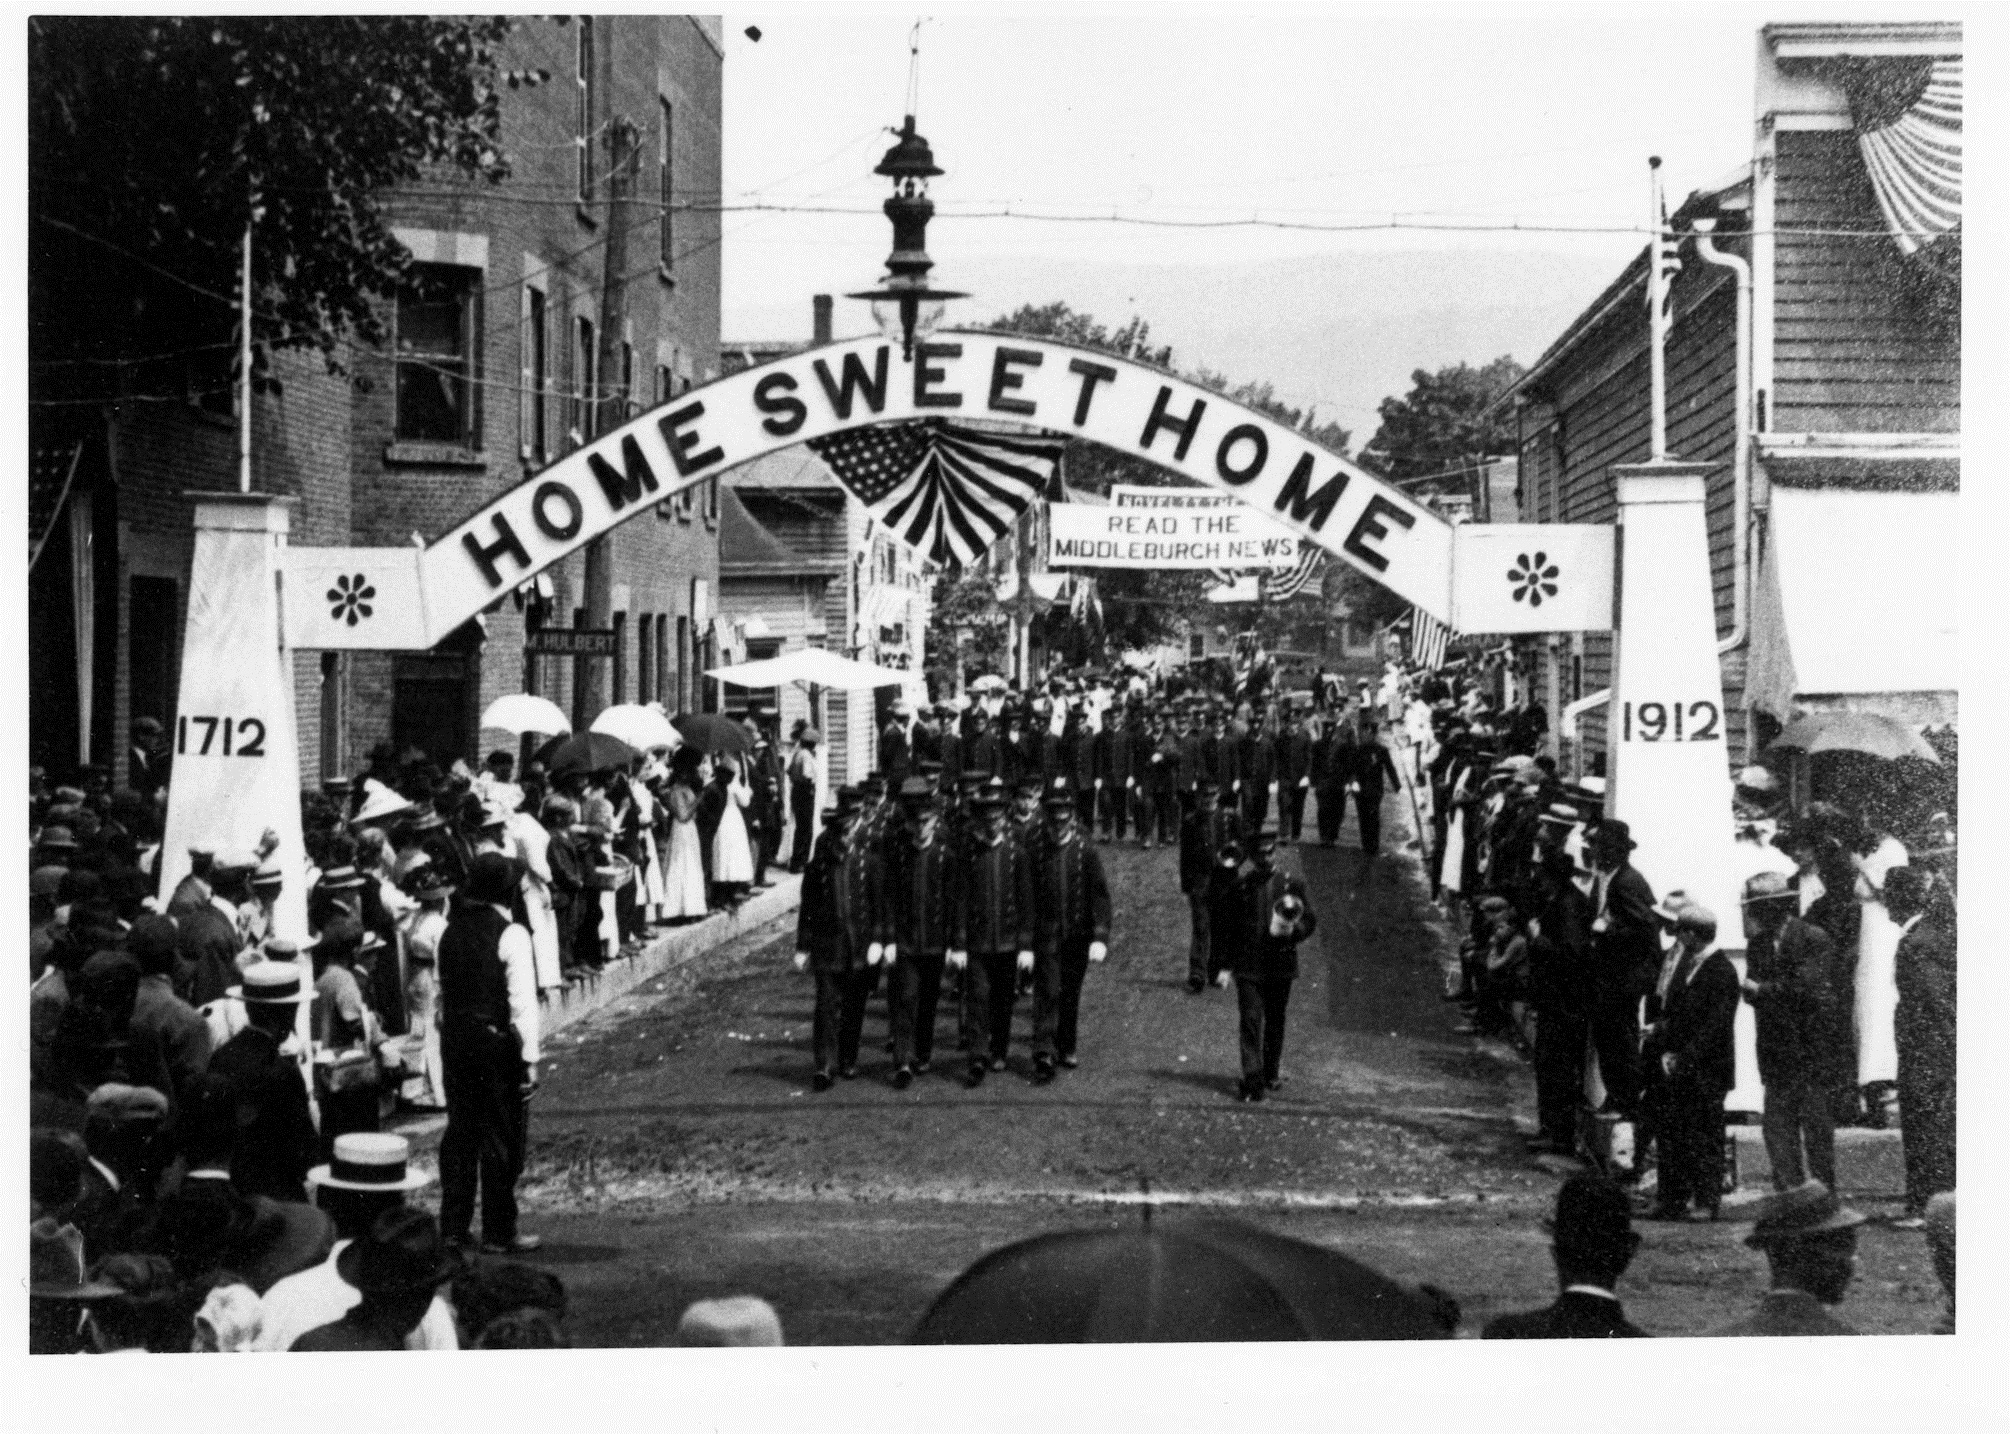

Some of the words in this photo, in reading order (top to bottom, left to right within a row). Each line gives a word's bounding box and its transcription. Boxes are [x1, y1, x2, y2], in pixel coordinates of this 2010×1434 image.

[462, 401, 724, 588] HOME
[754, 344, 1116, 437] SWEET
[1140, 386, 1415, 572] HOME
[1108, 516, 1178, 534] READ
[1192, 515, 1241, 533] THE
[1228, 537, 1293, 558] NEWS
[544, 632, 616, 652] HULBERT
[178, 715, 266, 757] 1712
[1623, 701, 1720, 741] 1912
